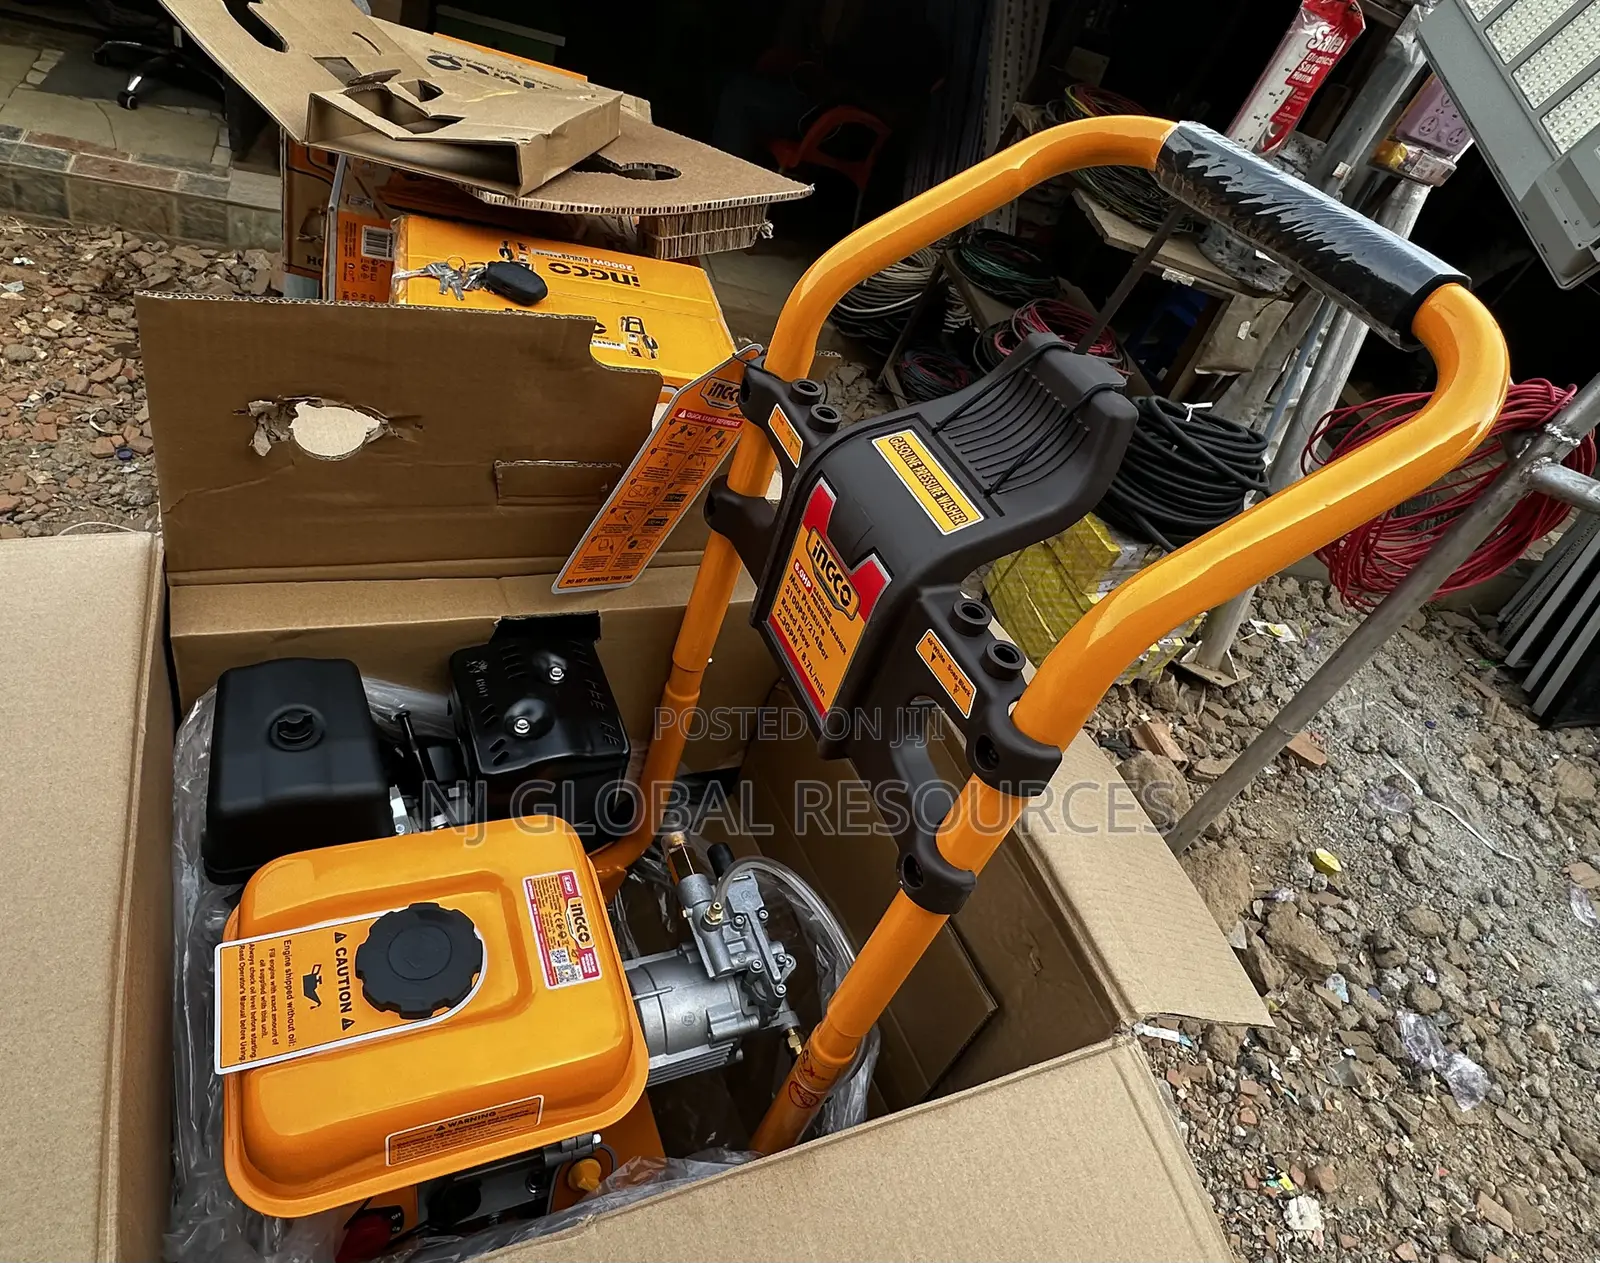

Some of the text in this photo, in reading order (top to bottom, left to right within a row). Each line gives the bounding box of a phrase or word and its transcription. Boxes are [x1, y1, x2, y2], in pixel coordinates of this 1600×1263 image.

[888, 436, 969, 526] GASOLINE PRESSURE WASHER
[780, 598, 811, 649] Rated Flow
[789, 574, 802, 594] Max
[801, 593, 826, 637] Pressure
[776, 609, 798, 648] 2.3GPM
[249, 985, 257, 994] oil
[259, 968, 267, 994] supplied
[283, 939, 296, 1047] Engine shipped without oil:
[335, 947, 353, 1014] CAUTION
[271, 1013, 279, 1036] amount
[447, 1111, 497, 1128] WARNING
